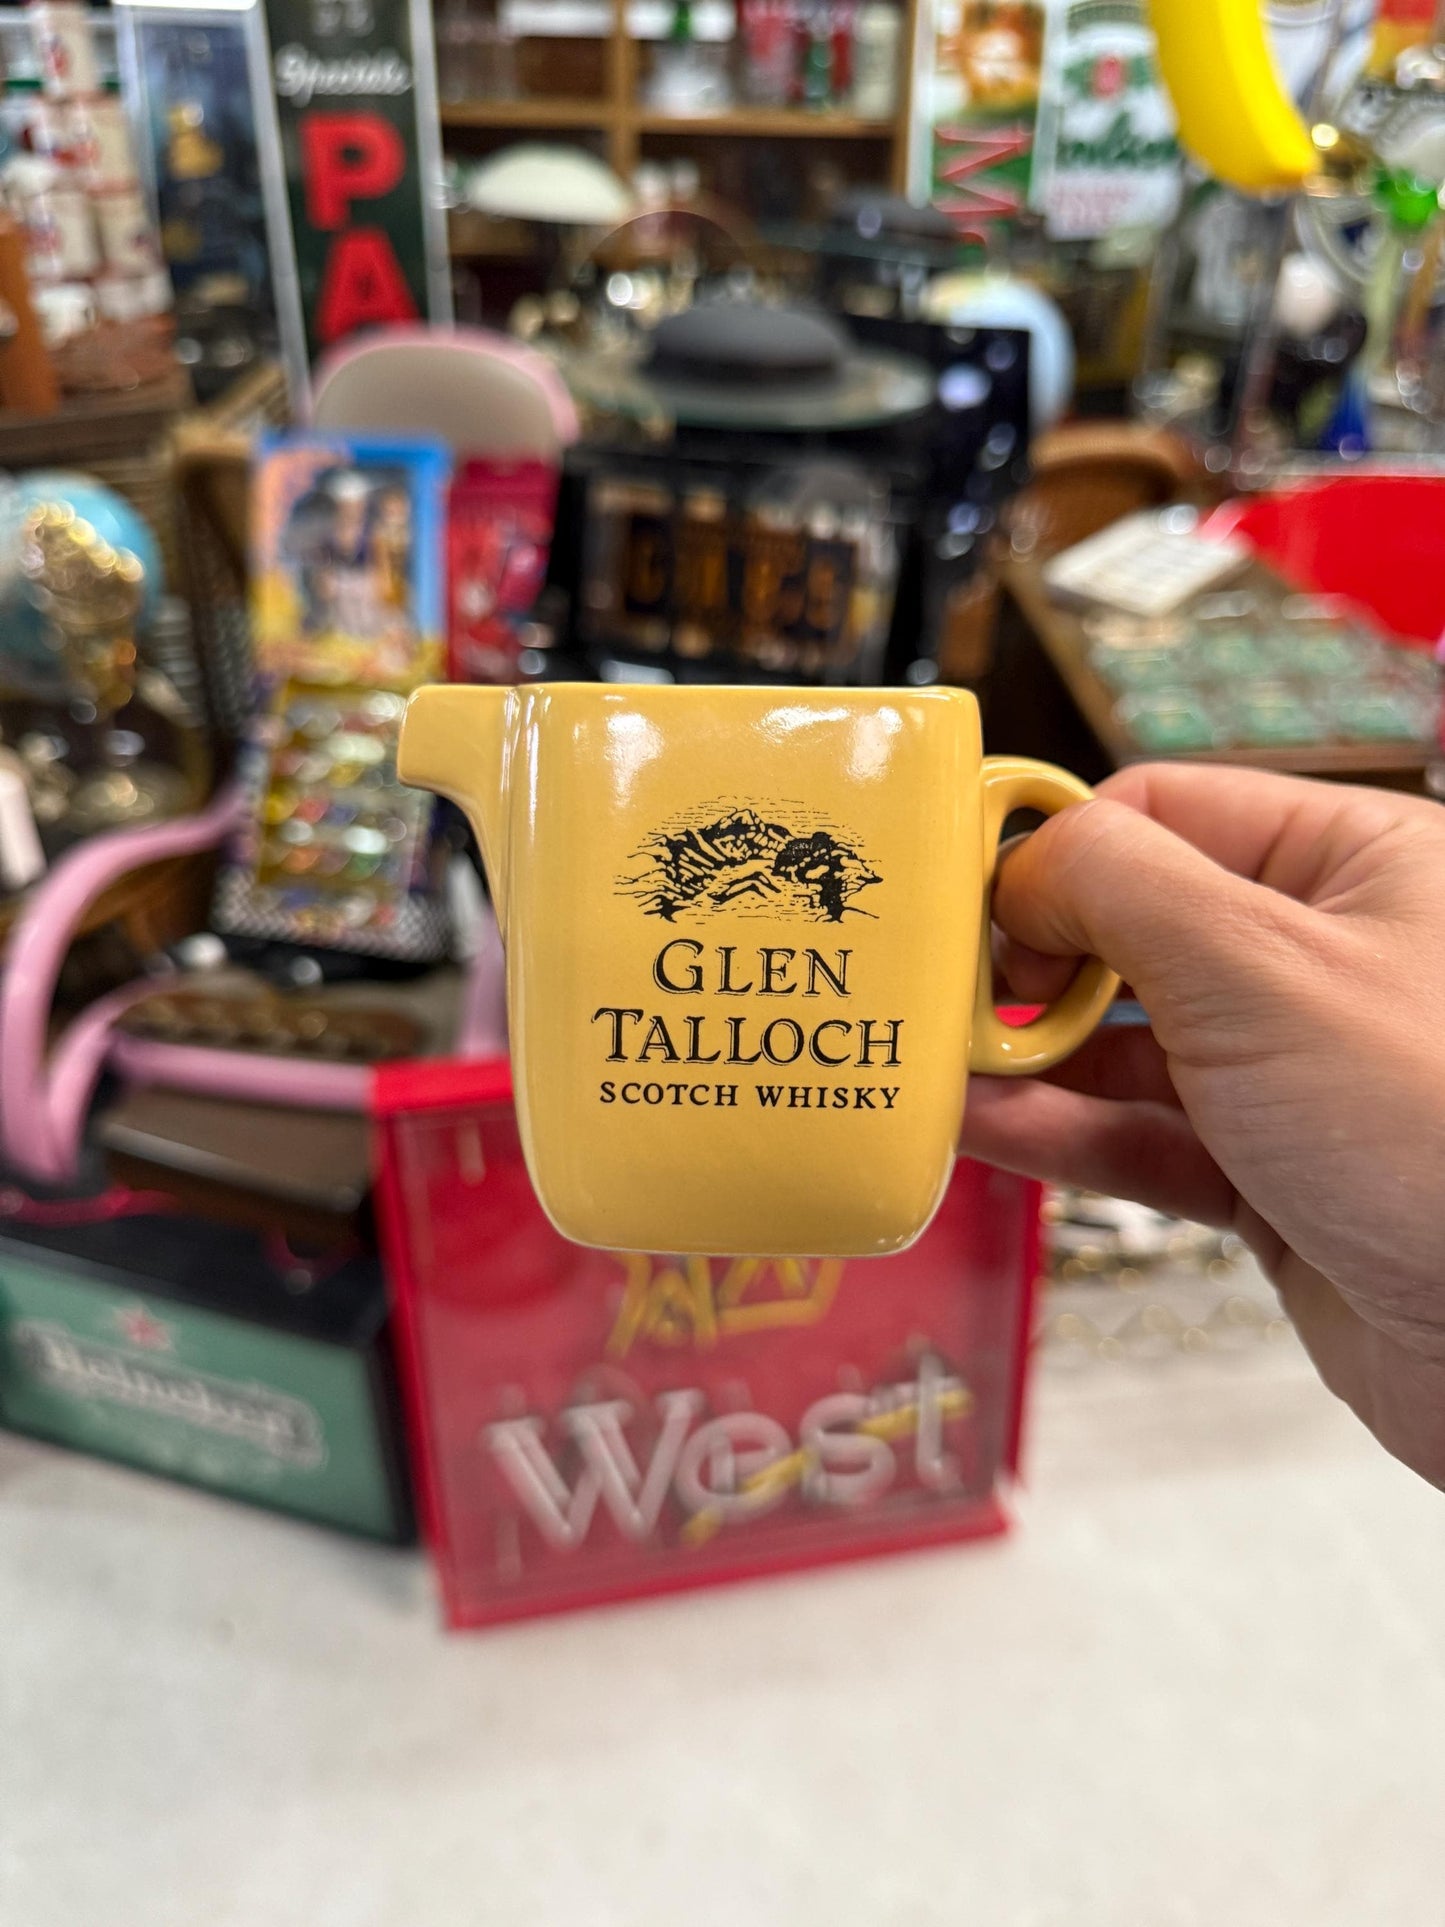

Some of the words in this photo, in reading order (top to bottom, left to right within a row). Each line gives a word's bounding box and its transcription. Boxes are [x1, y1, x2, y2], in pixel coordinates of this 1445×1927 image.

[653, 938, 853, 998] GLEN
[591, 1007, 904, 1068] TALLOCH
[600, 1081, 739, 1107] SCOTCH
[756, 1085, 901, 1109] WHISKY
[482, 1350, 970, 1552] West
